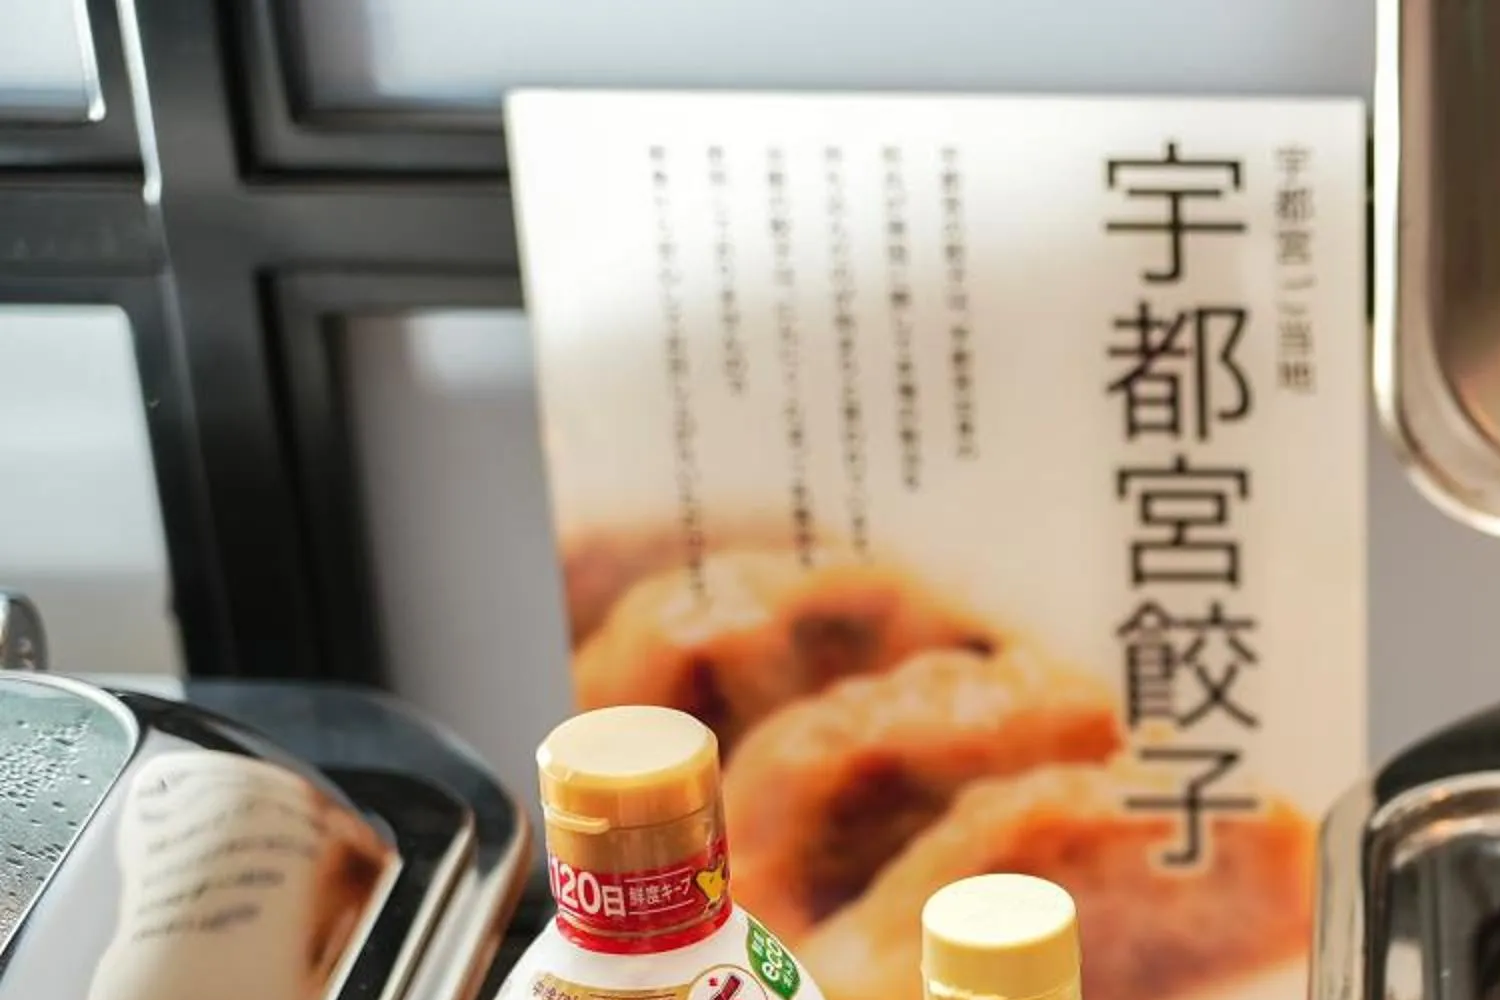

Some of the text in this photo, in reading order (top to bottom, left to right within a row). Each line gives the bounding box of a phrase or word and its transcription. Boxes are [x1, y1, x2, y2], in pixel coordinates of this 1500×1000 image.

[1103, 140, 1259, 866] 宇都宮餃子
[629, 875, 692, 906] 鮮度キープ
